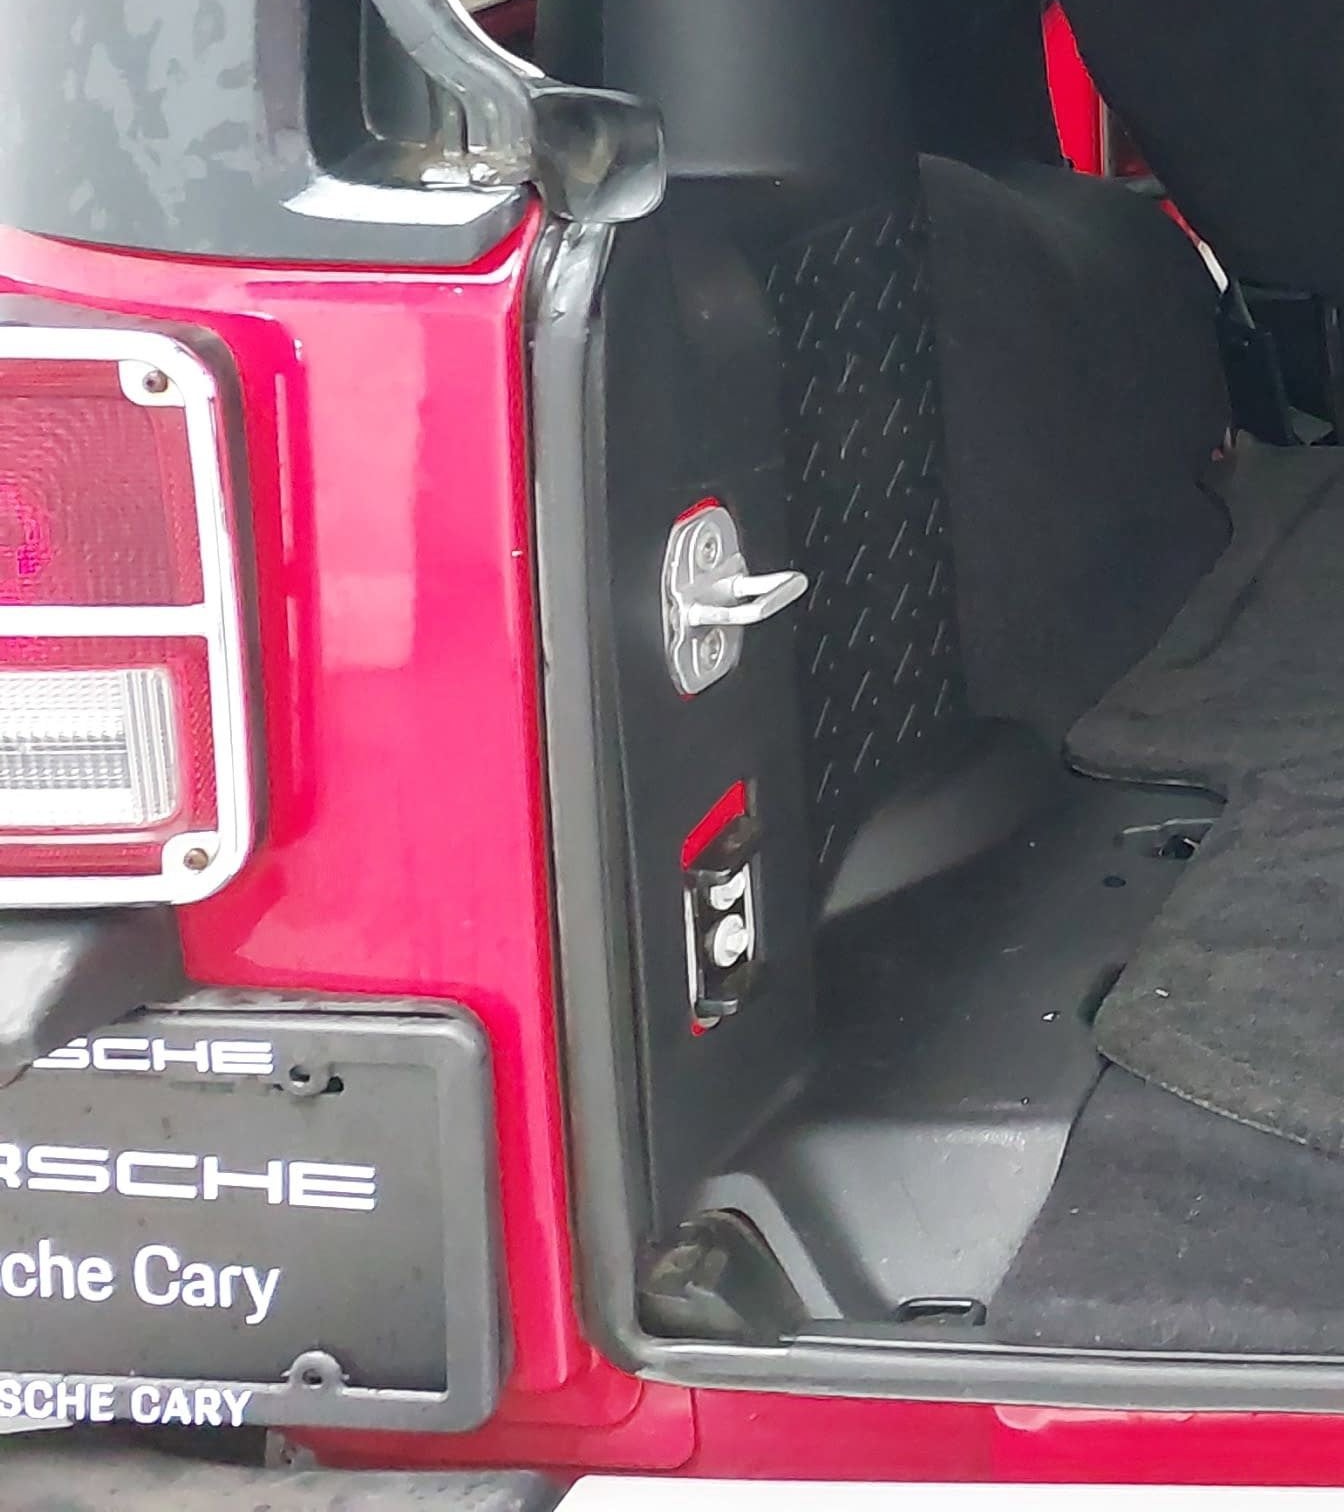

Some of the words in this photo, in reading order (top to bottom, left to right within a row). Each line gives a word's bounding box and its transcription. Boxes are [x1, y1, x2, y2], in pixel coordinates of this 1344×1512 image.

[0, 1142, 377, 1211] SCHE
[133, 1244, 281, 1325] Cary
[130, 1385, 254, 1428] CARY
